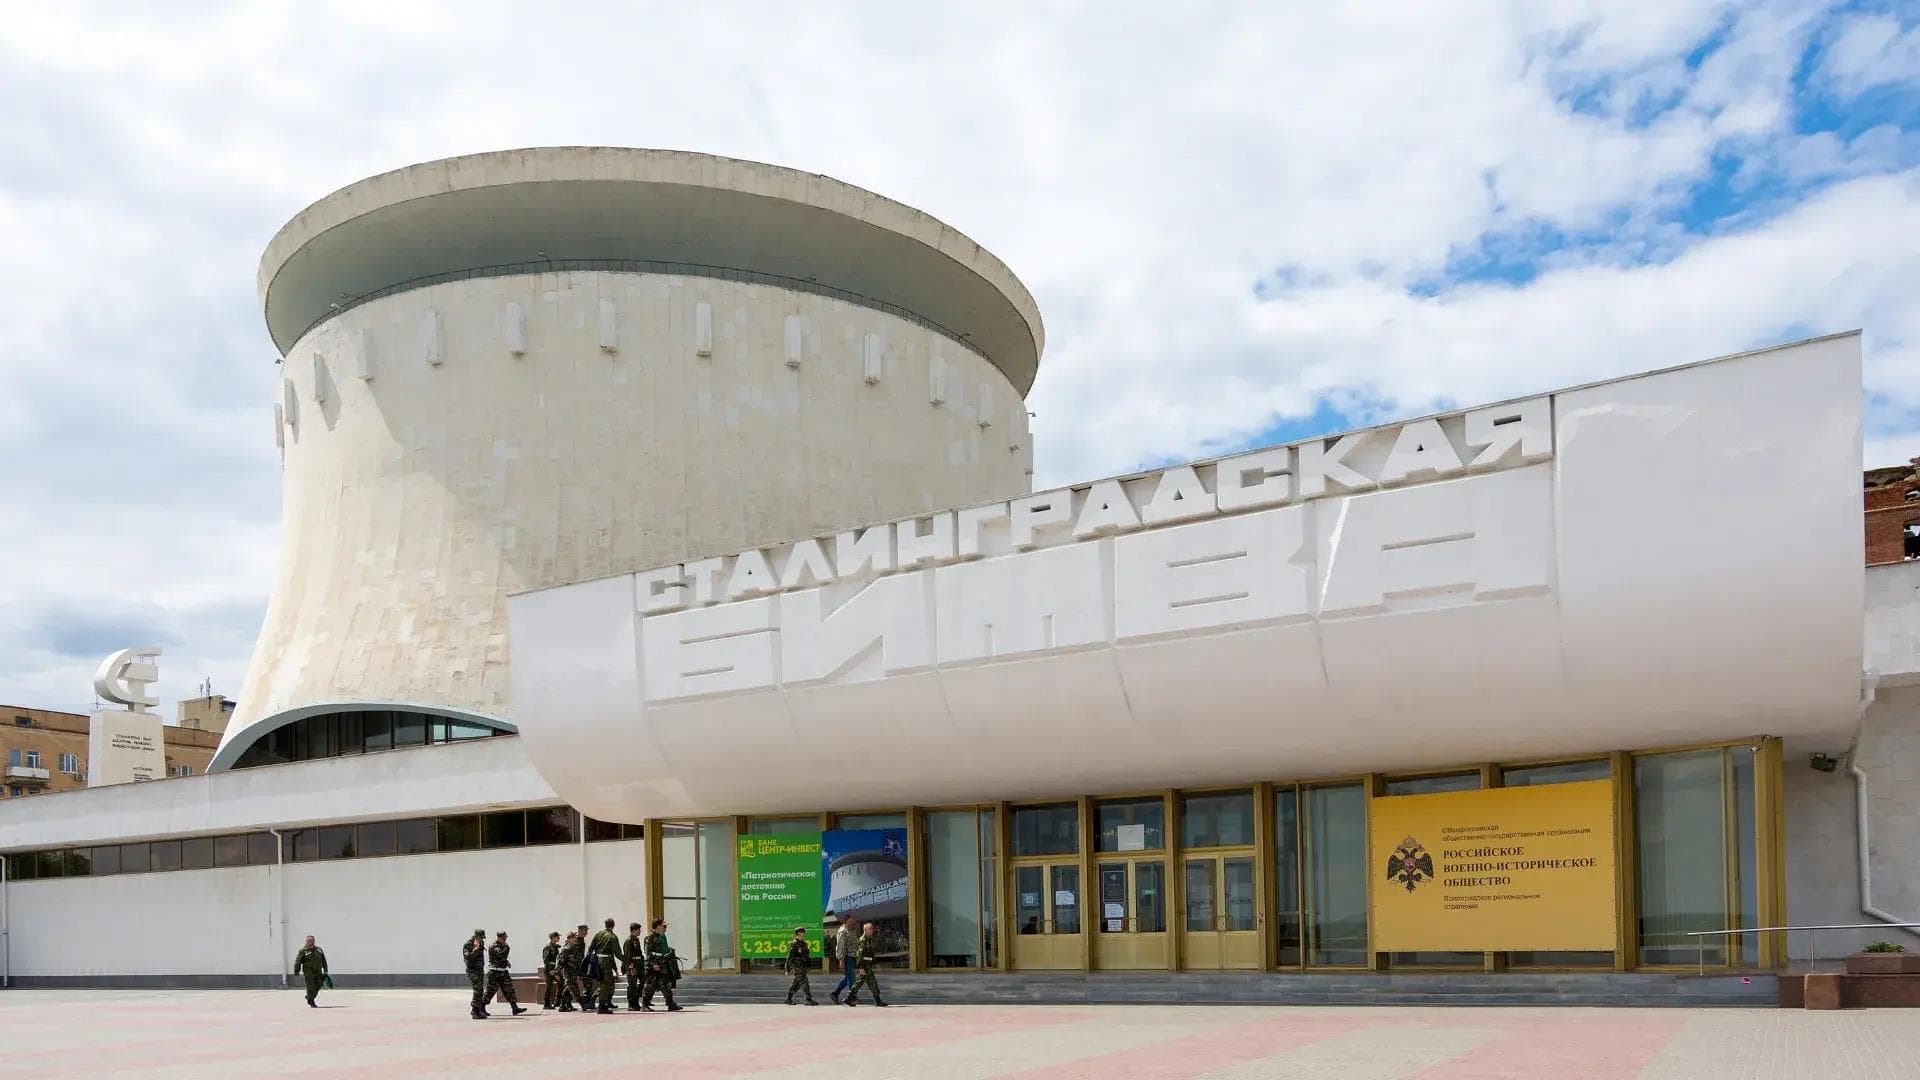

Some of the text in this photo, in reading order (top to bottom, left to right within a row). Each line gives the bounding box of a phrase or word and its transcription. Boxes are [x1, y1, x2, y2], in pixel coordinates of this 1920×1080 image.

[635, 396, 1553, 614] СТАЛИНГРАДСКАЯ
[758, 839, 778, 847] БАНК
[758, 844, 821, 855] ЦЕНТР-ИНВЕСТ
[1443, 846, 1525, 860] РОССИЙСКОЕ
[1443, 857, 1598, 873] ВОЕННО-ИСТОРИЧЕСКОЕ
[1443, 876, 1512, 888] ОБЩЕСТВО
